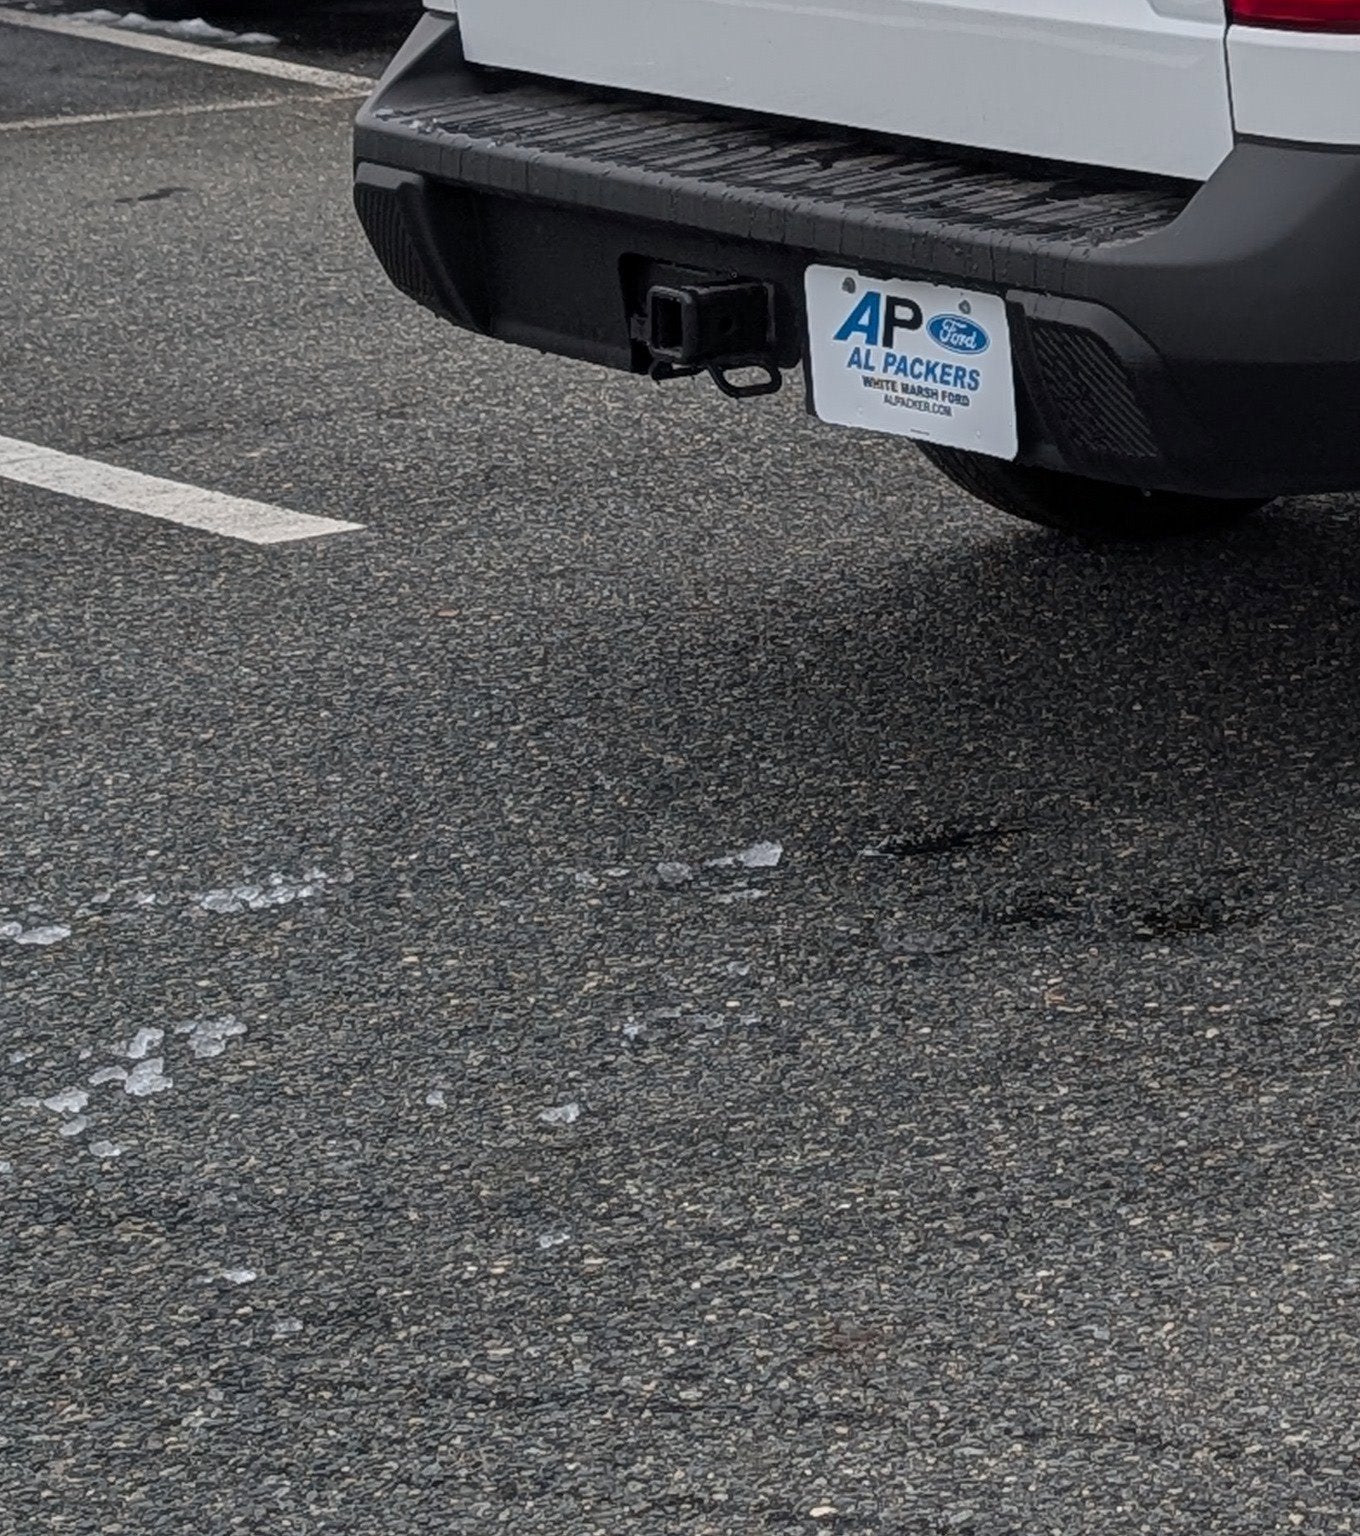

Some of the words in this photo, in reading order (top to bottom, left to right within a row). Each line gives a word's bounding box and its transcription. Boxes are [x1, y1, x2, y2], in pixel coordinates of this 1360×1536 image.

[833, 291, 923, 349] AP
[938, 318, 978, 349] Ford
[847, 346, 876, 372] AL
[882, 352, 981, 391] PACKERS
[862, 375, 899, 393] WHITE
[900, 382, 939, 401] MARSH
[941, 390, 970, 407] FORD
